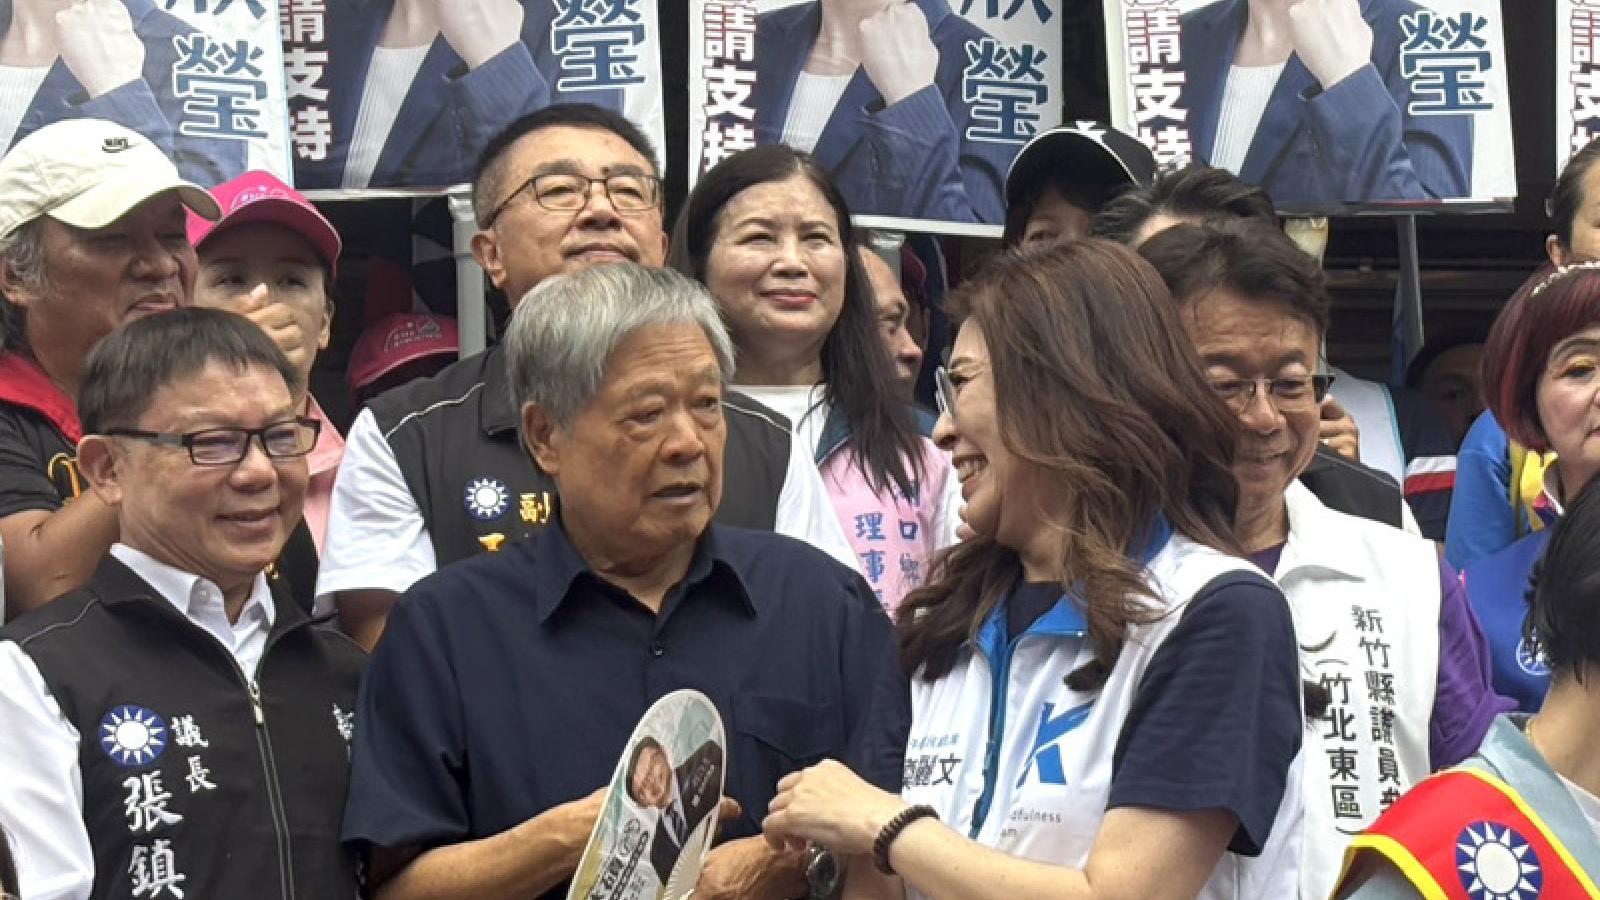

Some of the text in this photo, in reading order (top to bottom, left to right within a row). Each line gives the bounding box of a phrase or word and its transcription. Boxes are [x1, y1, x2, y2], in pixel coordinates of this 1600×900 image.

[165, 0, 269, 139] 瑩
[960, 0, 1053, 143] 瑩
[1400, 11, 1495, 116] 瑩
[854, 511, 888, 606] 理事
[170, 714, 217, 793] 議長
[122, 769, 185, 899] 張鎮
